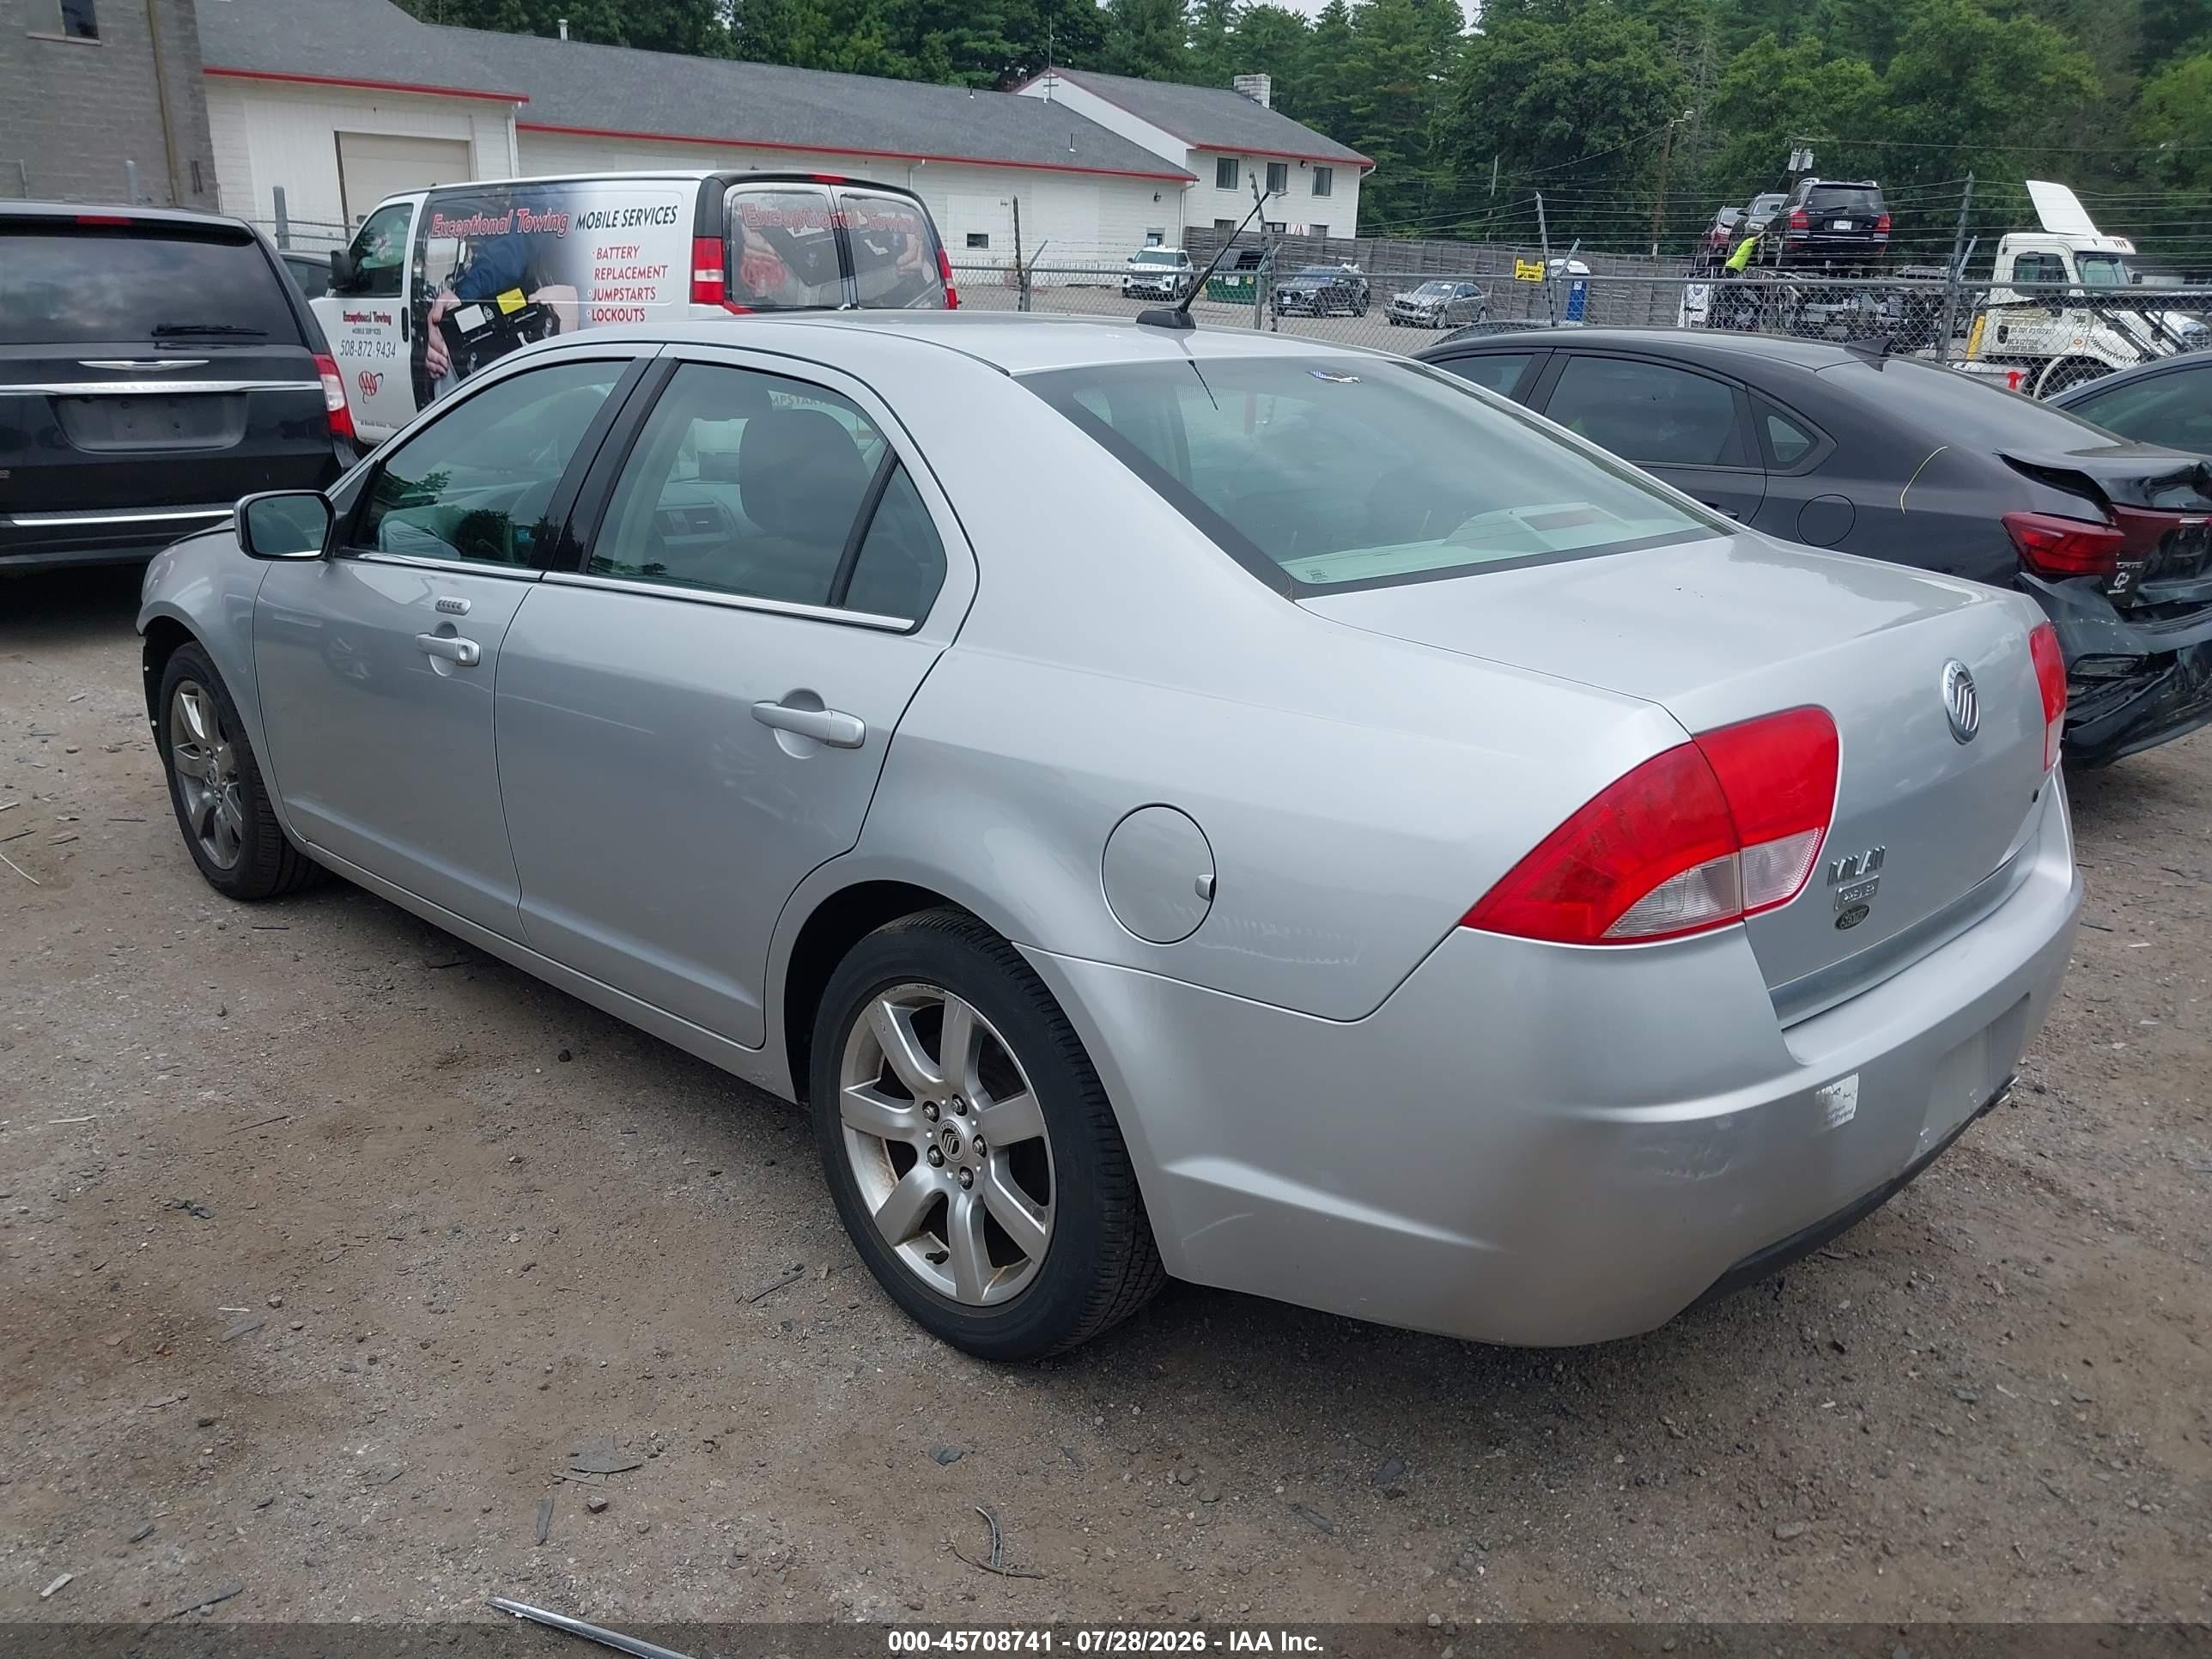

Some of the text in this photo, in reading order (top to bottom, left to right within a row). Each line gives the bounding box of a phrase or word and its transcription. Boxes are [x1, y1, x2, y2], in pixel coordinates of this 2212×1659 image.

[431, 205, 678, 241] Exceptional Towing MOBILE SERVICES
[596, 246, 641, 260] BATTERY
[594, 264, 668, 281] REPLACEMENT
[592, 287, 656, 301] JUMPSTARTS
[372, 311, 392, 326] Towing
[592, 308, 646, 322] LOCKOUTS
[340, 340, 396, 358] 508-872-9434
